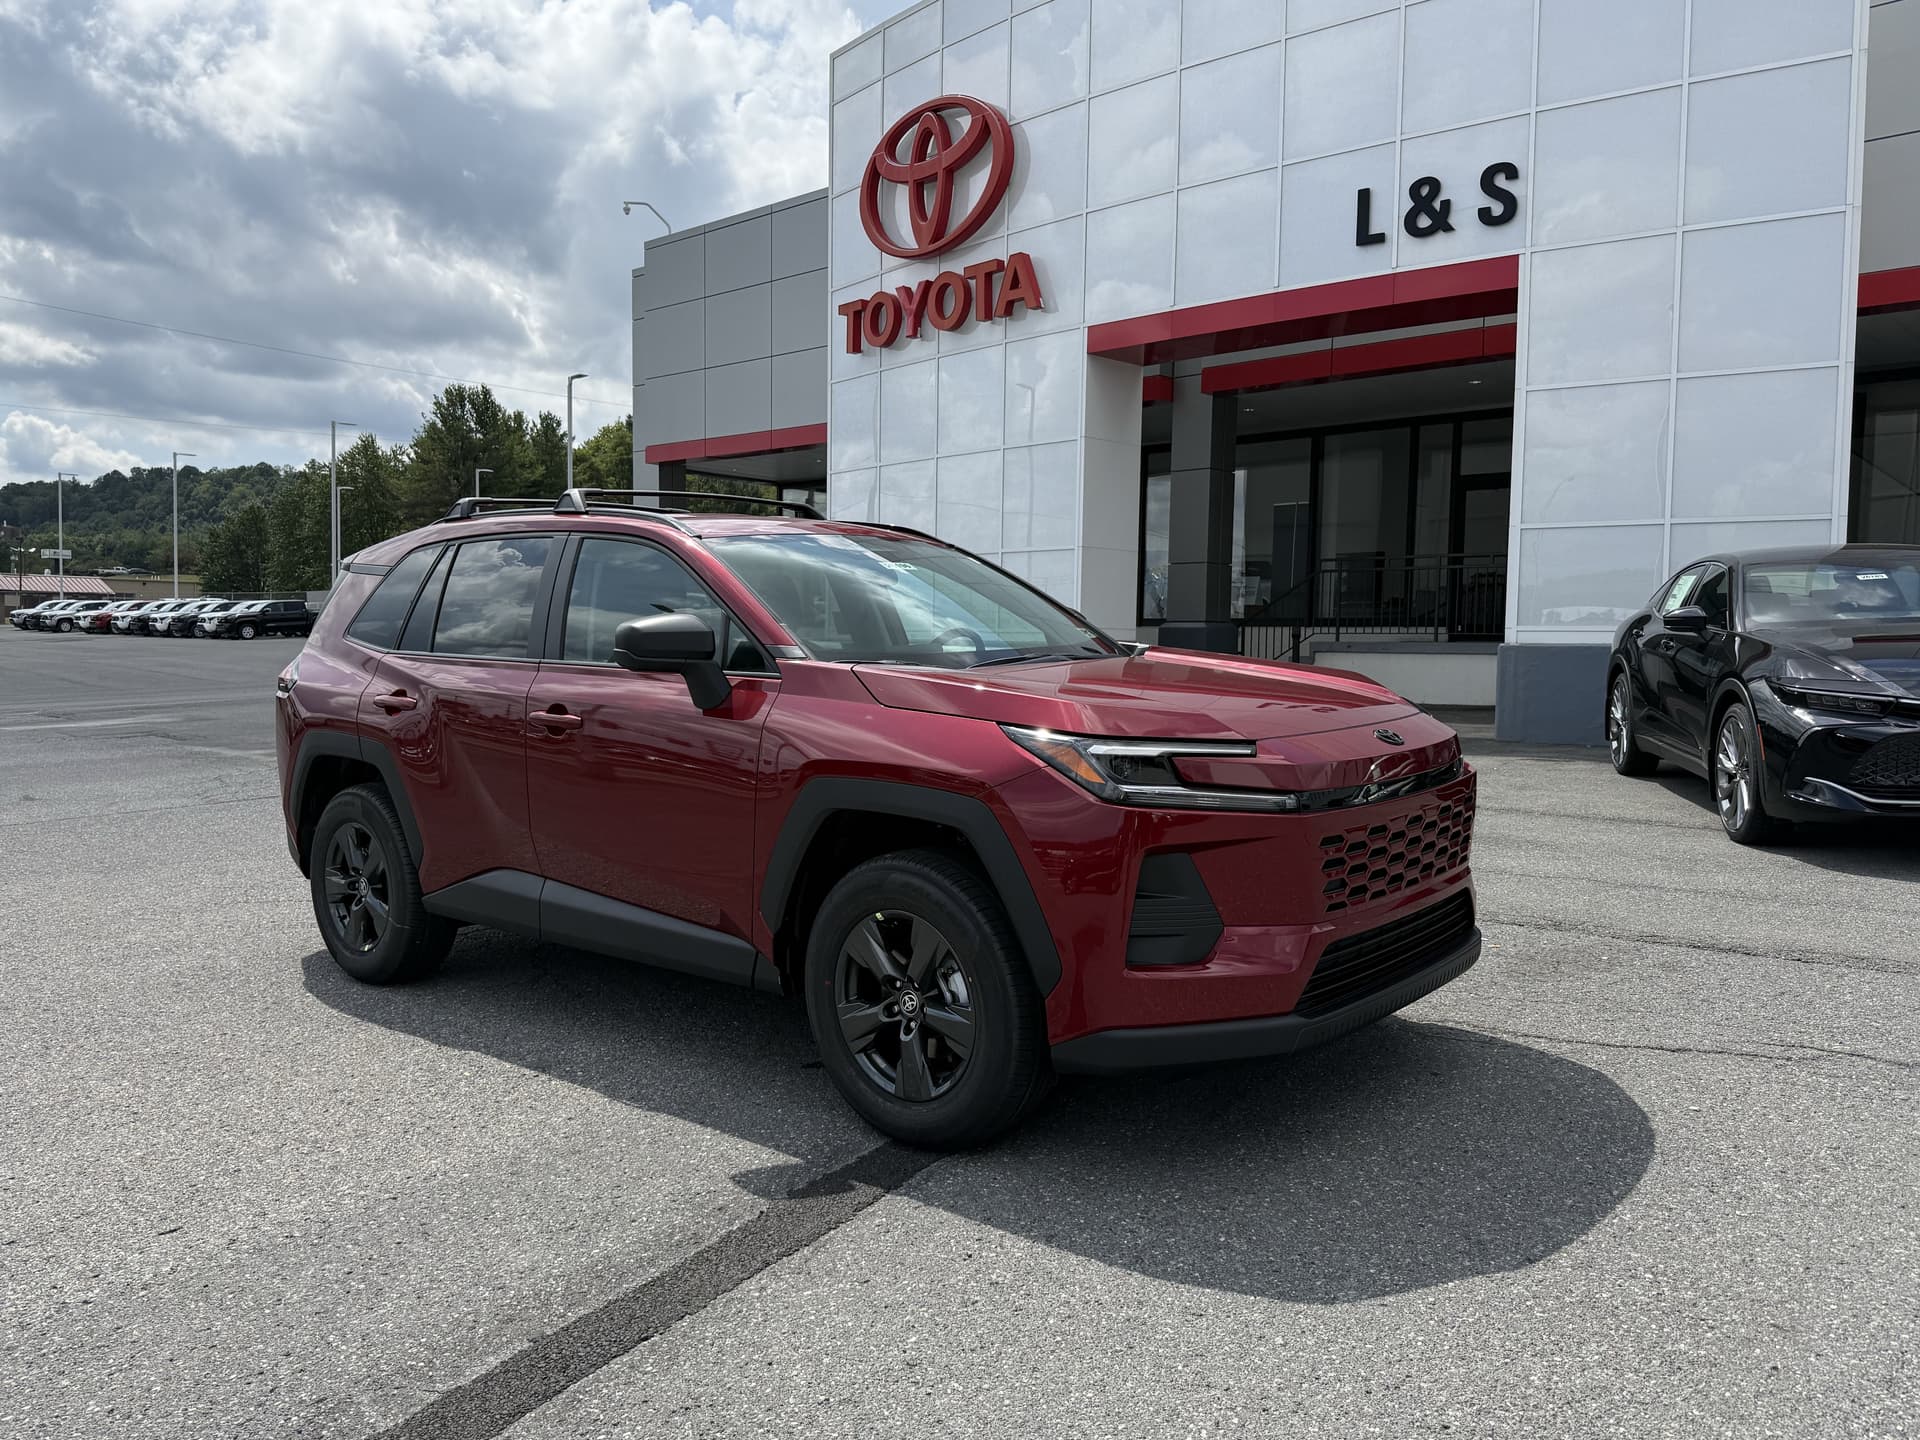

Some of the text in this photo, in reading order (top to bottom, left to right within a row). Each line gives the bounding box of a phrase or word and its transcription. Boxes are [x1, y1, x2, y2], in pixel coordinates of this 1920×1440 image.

[1356, 161, 1519, 247] L & S
[838, 251, 1043, 355] TOYOTA
